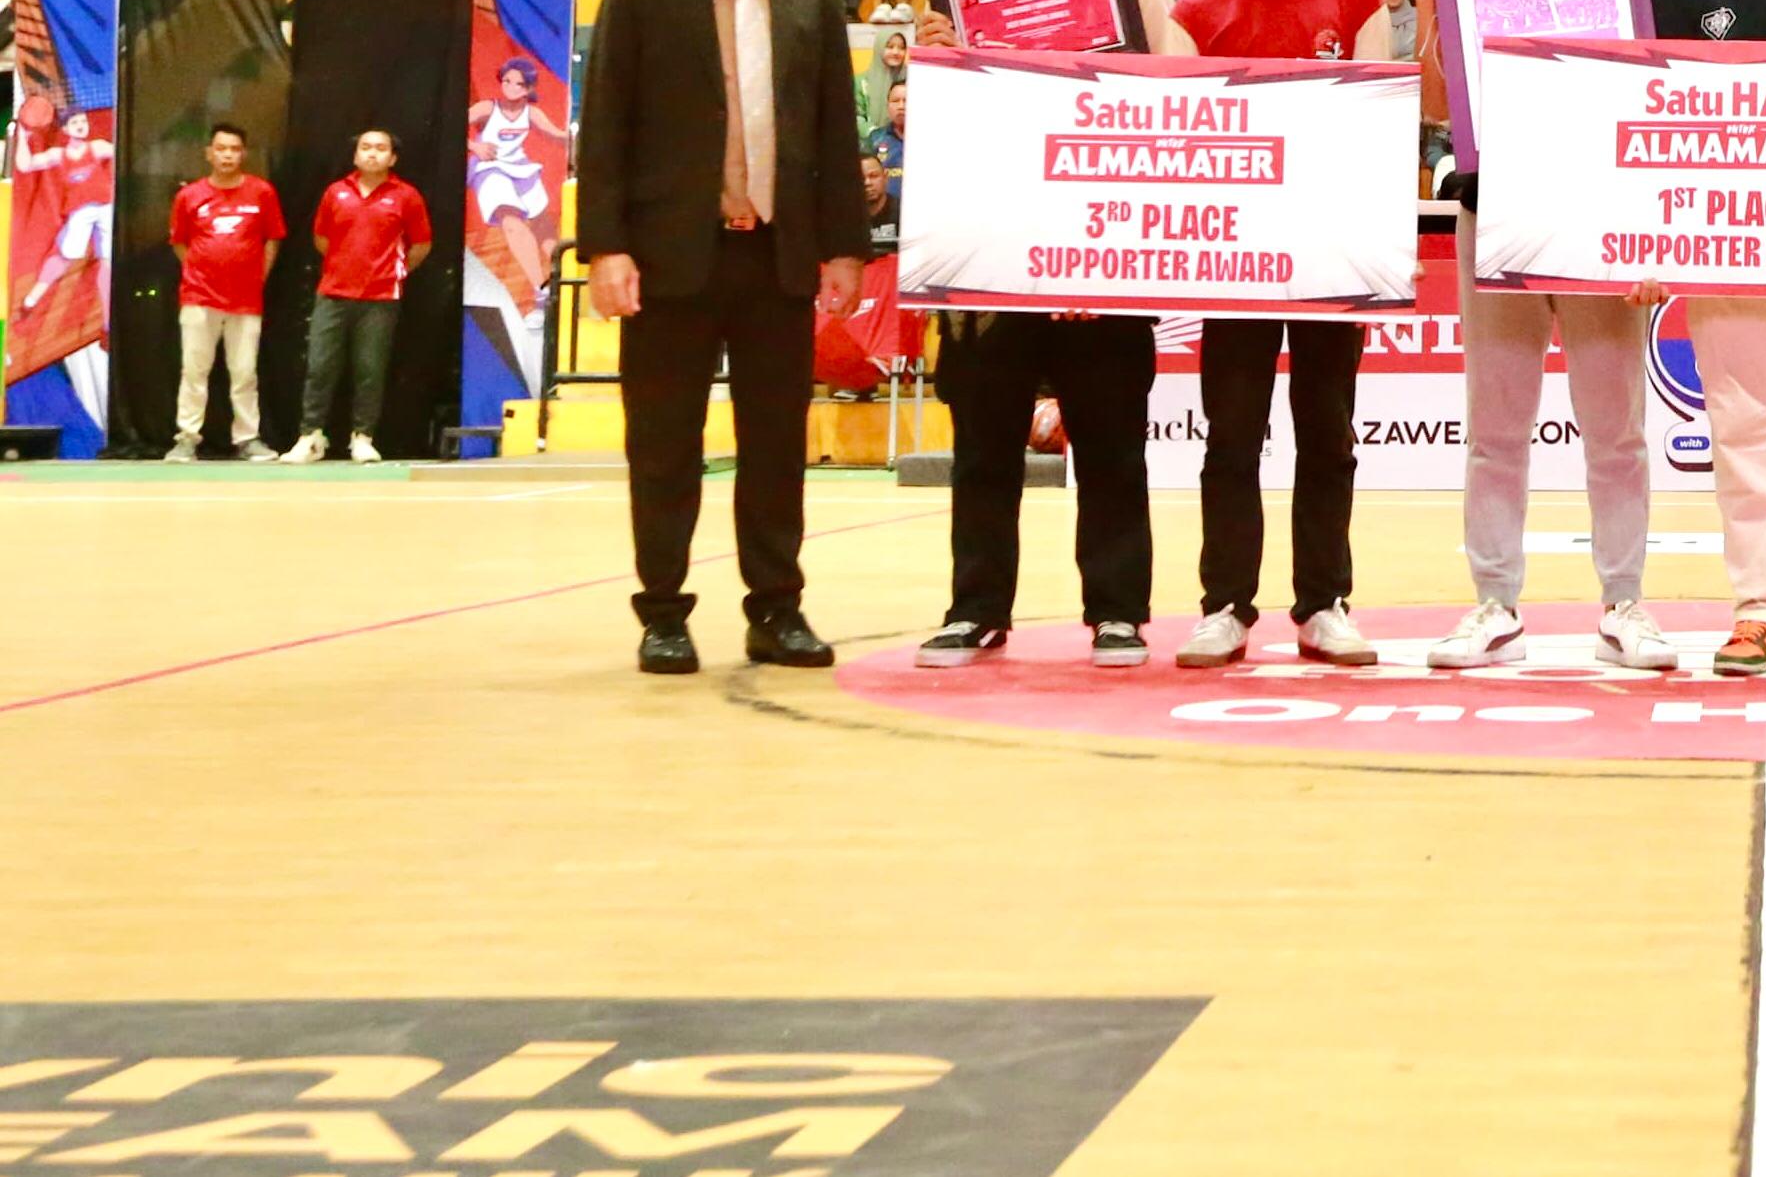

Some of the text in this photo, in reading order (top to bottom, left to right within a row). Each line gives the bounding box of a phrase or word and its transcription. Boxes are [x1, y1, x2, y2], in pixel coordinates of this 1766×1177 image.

[1074, 91, 1249, 134] Satu HATI
[1645, 78, 1723, 116] Satu
[1050, 145, 1276, 180] ALMAMATER
[1085, 200, 1239, 242] 3RD PLACE
[1657, 186, 1698, 225] 1ST
[1028, 245, 1294, 284] SUPPORTER AWARD
[1601, 232, 1761, 268] SUPPORTER
[1679, 437, 1703, 449] with
[1170, 697, 1596, 723] One
